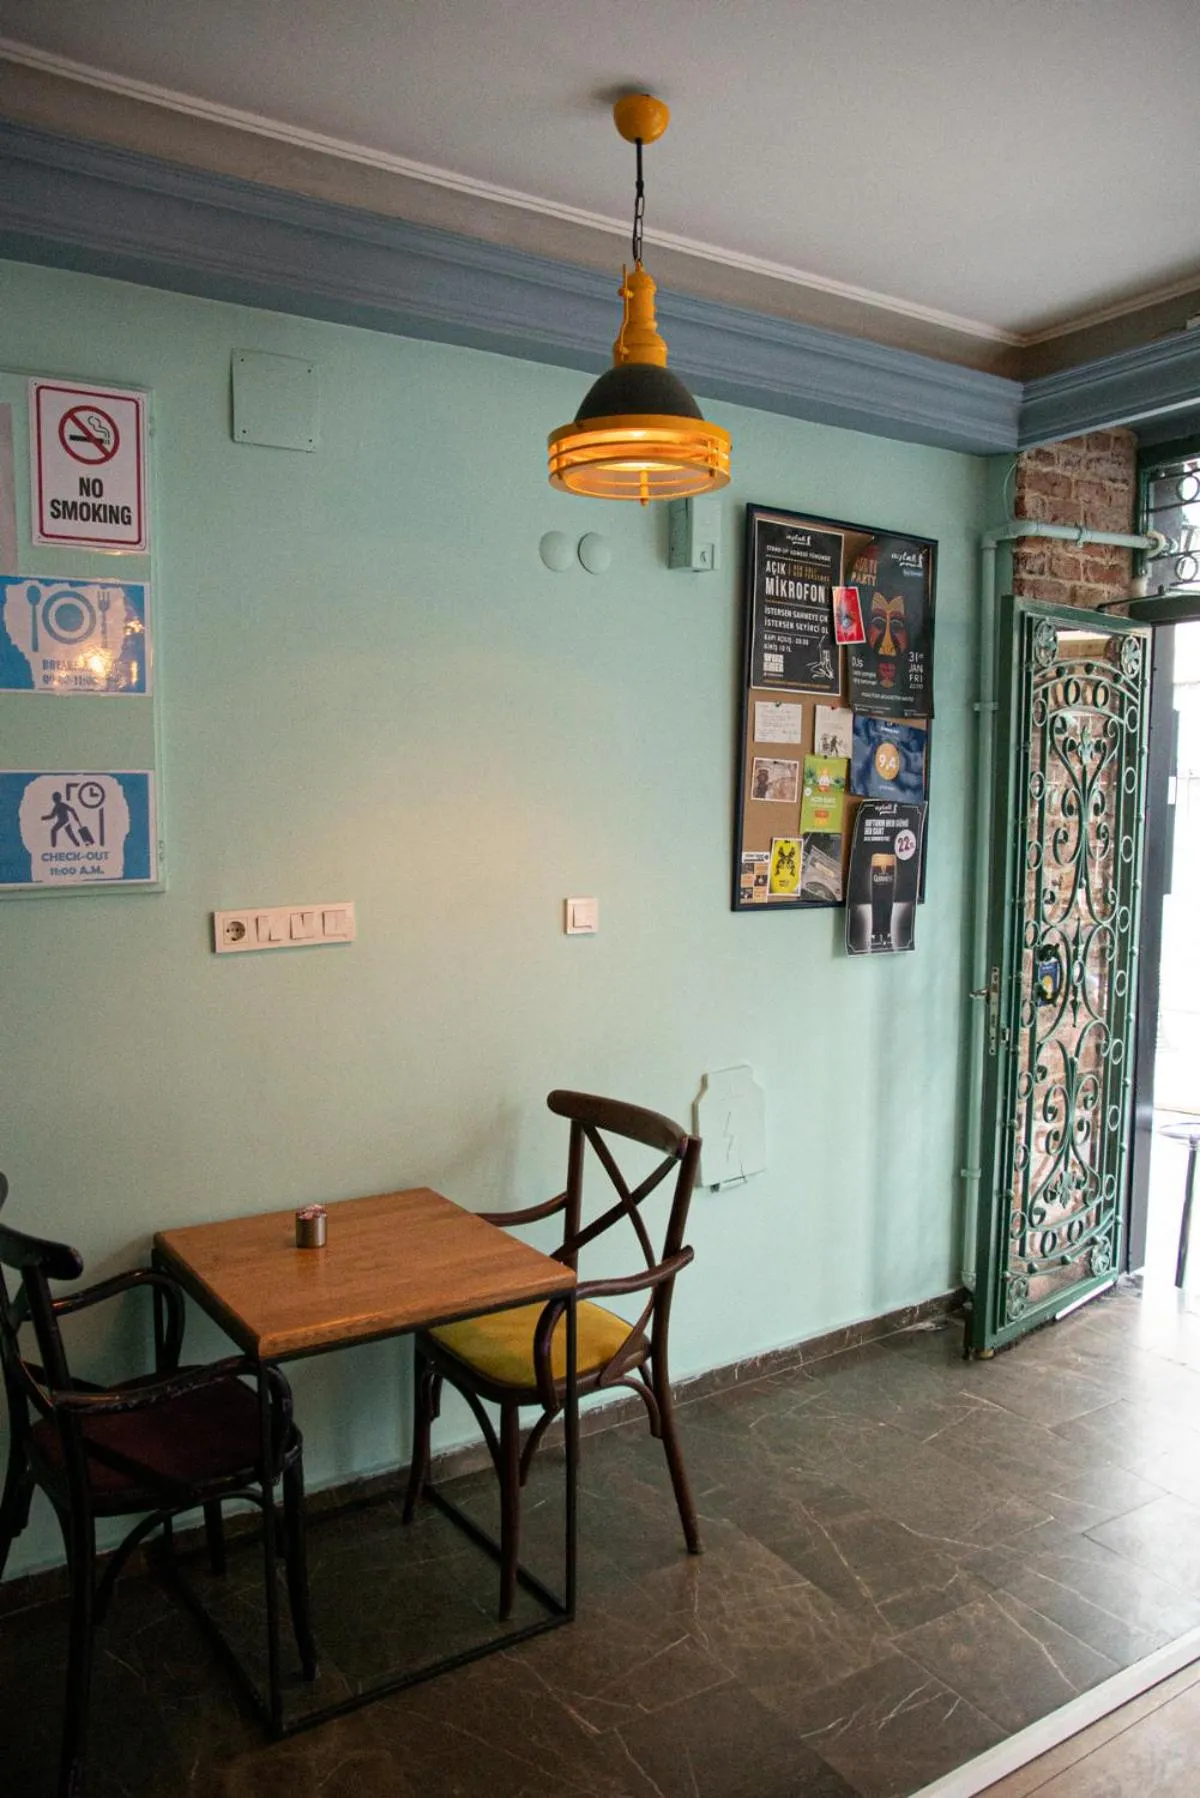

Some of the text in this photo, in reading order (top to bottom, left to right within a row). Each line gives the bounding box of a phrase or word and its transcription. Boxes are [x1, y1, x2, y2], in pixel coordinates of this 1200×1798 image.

[79, 477, 104, 498] NO
[50, 498, 132, 526] SMOKING
[765, 560, 786, 576] AÇIK
[765, 575, 826, 603] MİKROFON
[764, 616, 794, 629] İSTERSEN
[908, 663, 924, 674] JAN
[909, 674, 924, 683] FRI
[41, 851, 110, 862] CHECK-OUT
[50, 865, 105, 877] 11:00 A.M.
